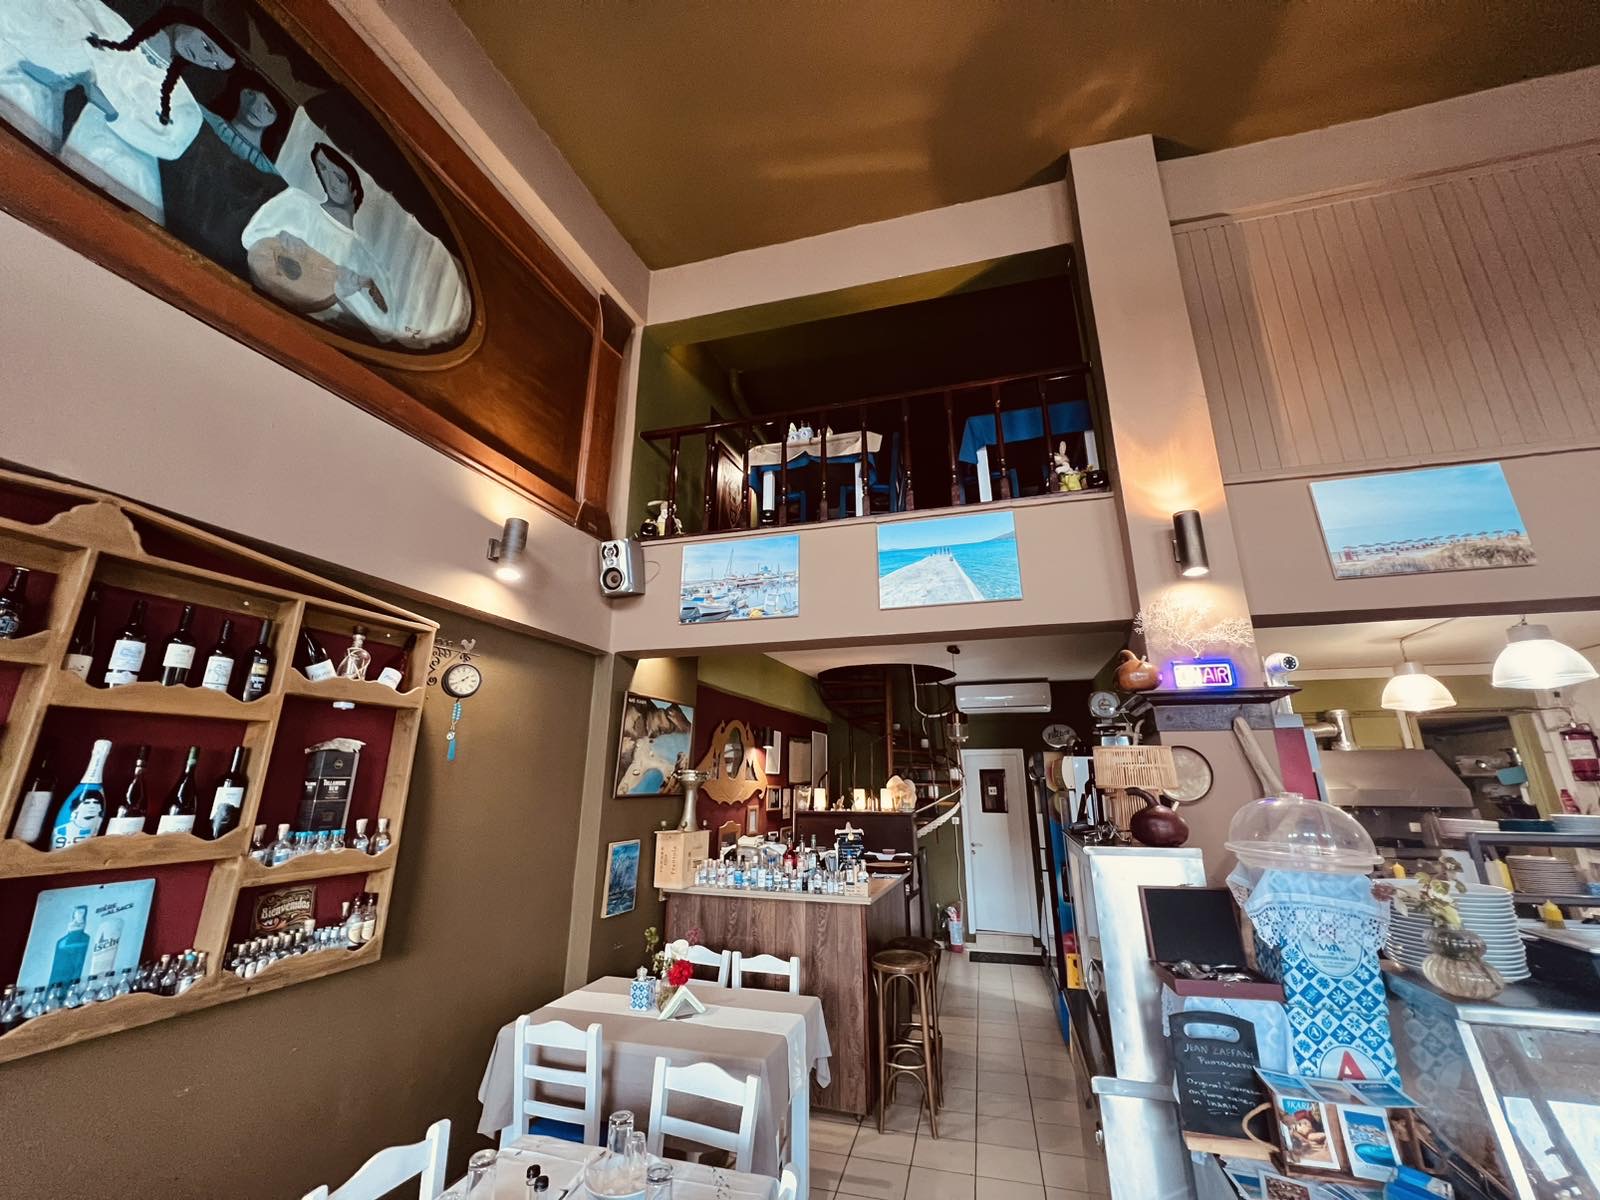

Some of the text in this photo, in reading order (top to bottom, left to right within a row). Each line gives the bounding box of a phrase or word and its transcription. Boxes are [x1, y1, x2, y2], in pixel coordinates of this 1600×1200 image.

[1203, 667, 1228, 683] AIR
[261, 896, 310, 919] Bienvenidos
[1183, 1043, 1208, 1054] JEAN
